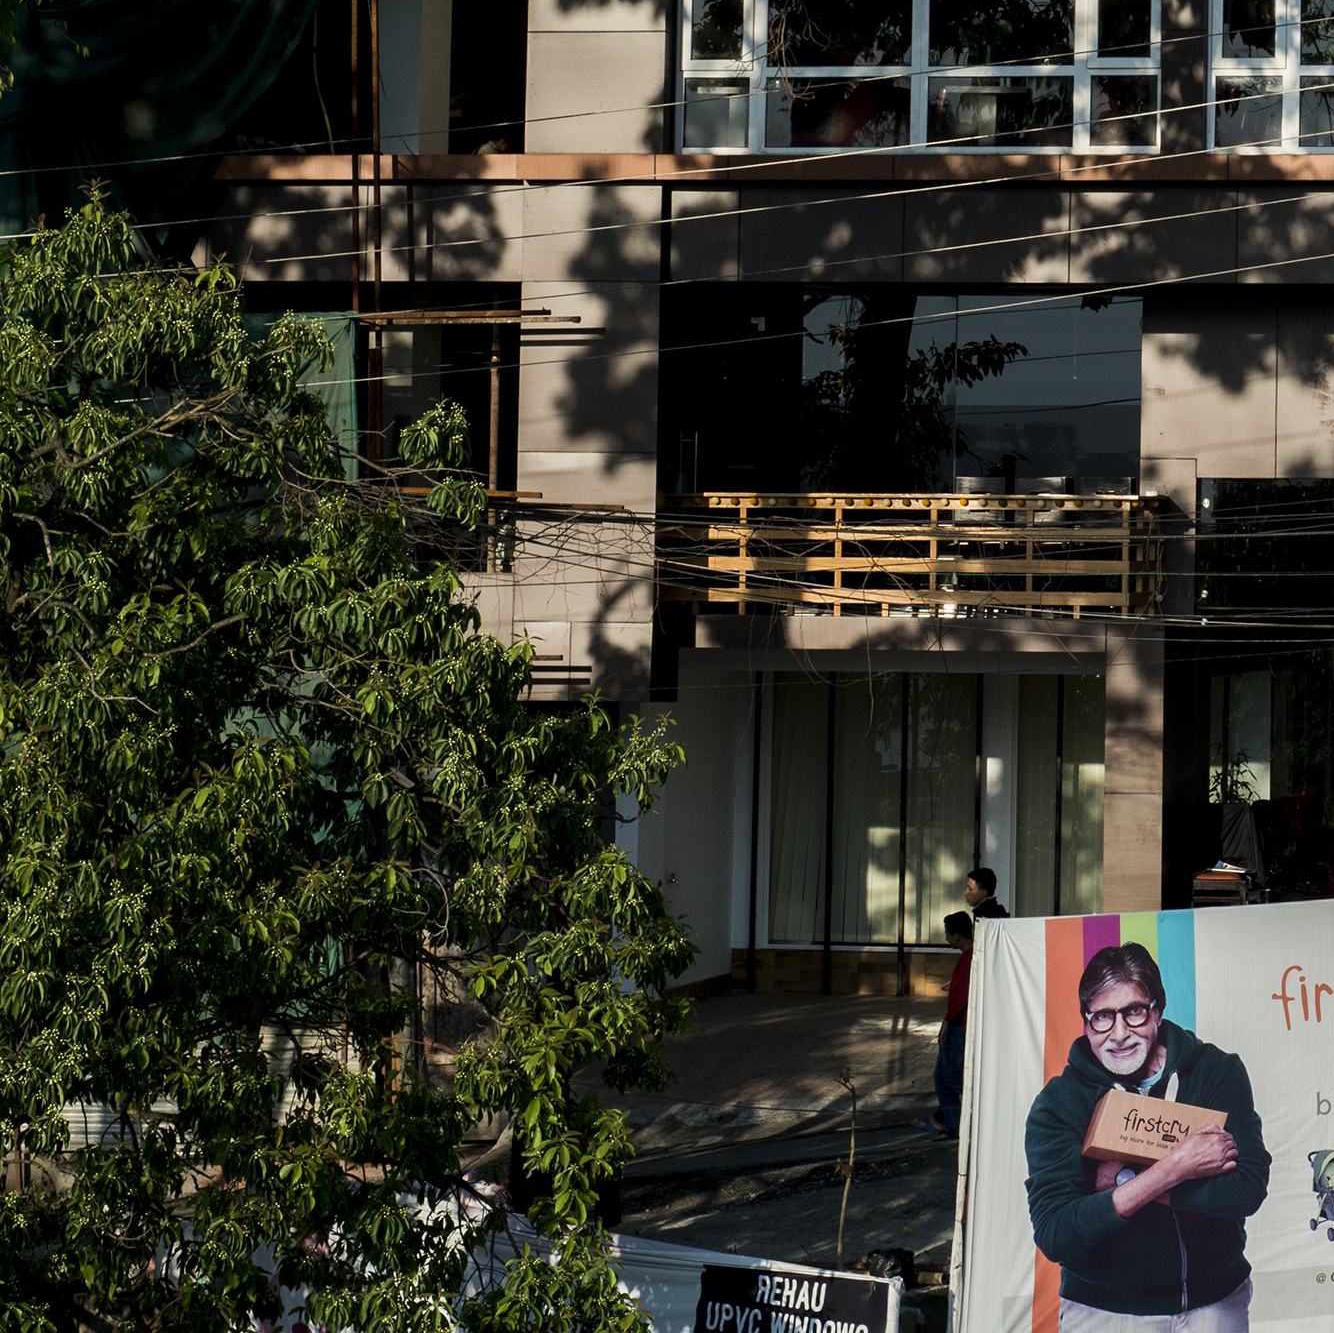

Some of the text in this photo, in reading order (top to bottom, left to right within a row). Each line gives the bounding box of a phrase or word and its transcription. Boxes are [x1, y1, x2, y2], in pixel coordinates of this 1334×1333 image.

[1123, 1108, 1190, 1138] firstcry
[755, 1274, 827, 1313] REHAU
[1315, 1272, 1327, 1284] @
[705, 1300, 762, 1333] UPVC
